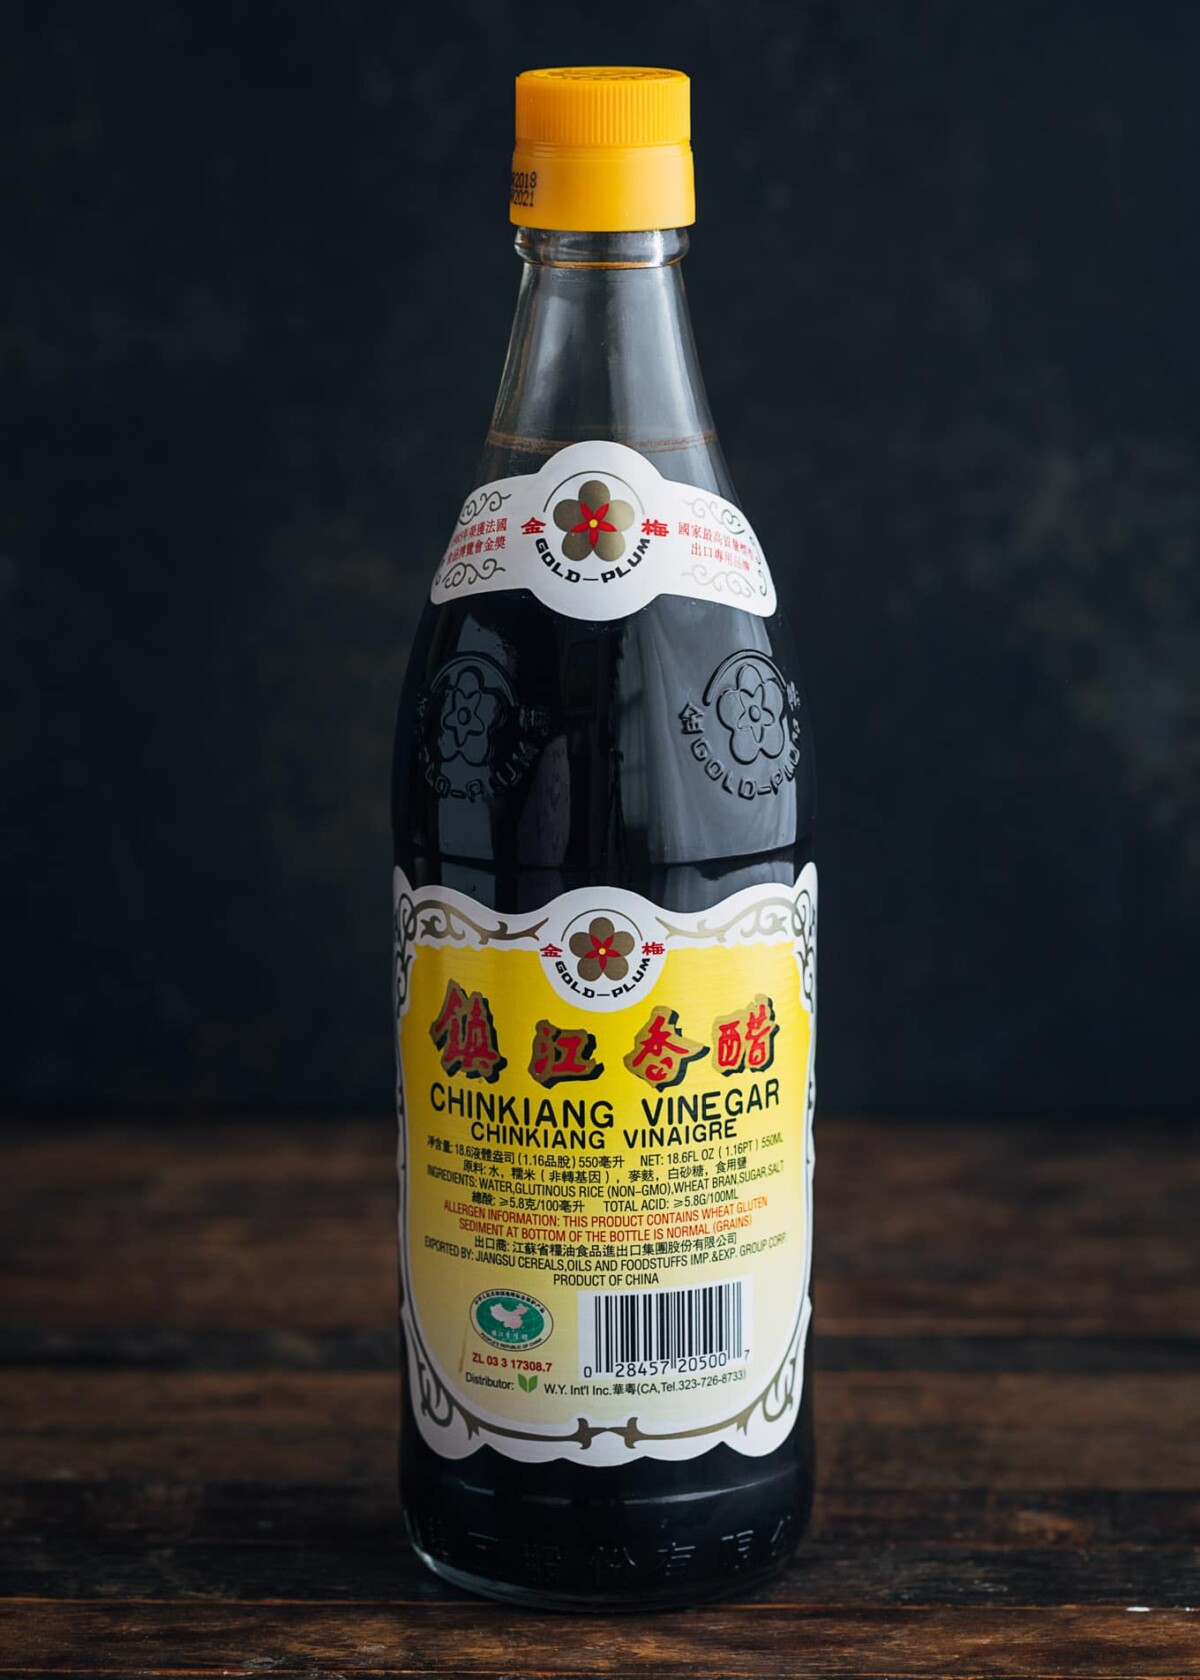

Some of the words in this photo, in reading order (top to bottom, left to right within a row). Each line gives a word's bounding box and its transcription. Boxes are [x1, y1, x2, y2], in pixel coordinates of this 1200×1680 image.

[521, 516, 546, 535] 金
[641, 518, 669, 537] 梅
[535, 538, 651, 583] GOLD-PLUM
[540, 943, 563, 958] 金
[642, 942, 665, 956] 梅
[555, 957, 651, 998] GOLD-PLUM
[430, 1081, 614, 1128] CHINKIANG
[642, 1078, 780, 1126] VINEGAR
[471, 1120, 605, 1150] CHINKIANG
[623, 1118, 737, 1149] VINAIGRE
[640, 1154, 664, 1167] NET:
[667, 1151, 698, 1165] 18.6FL
[702, 1147, 714, 1160] OZ
[761, 1131, 784, 1150] 550ML
[427, 1164, 477, 1188] INGREDIENTS:
[579, 1186, 604, 1198] RICE
[444, 1200, 485, 1219] ALLERGEN
[488, 1208, 560, 1228] INFORMATION:
[563, 1215, 588, 1228] THIS
[592, 1215, 643, 1229] PRODUCT
[647, 1209, 699, 1226] CONTAINS
[701, 1204, 734, 1220] WHEAT
[737, 1196, 768, 1213] GLUTEN
[604, 1201, 638, 1213] TOTAL
[641, 1199, 669, 1211] ACID:
[459, 1217, 505, 1237] SEDIMENT
[506, 1226, 519, 1238] AT
[522, 1228, 566, 1242] BOTTOM
[569, 1230, 583, 1243] OF
[585, 1231, 606, 1243] THE
[610, 1230, 650, 1243] BOTTLE
[654, 1228, 664, 1240] IS
[667, 1223, 710, 1239] NORMAL
[712, 1215, 753, 1234] (GRAINS)
[424, 1235, 459, 1258] EXPORTED
[461, 1247, 474, 1261] BY:
[475, 1250, 515, 1267] JIANGSU
[595, 1260, 618, 1273] AND
[621, 1254, 688, 1271] FOODSTUFFS
[740, 1239, 768, 1256] GROUP
[554, 1273, 606, 1287] PRODUCT
[609, 1274, 623, 1286] OF
[625, 1273, 659, 1286] CHINA
[472, 1352, 485, 1364] ZL
[487, 1356, 499, 1367] 03
[501, 1358, 507, 1368] 3
[511, 1359, 552, 1372] 17308.7
[584, 1366, 592, 1379] 0
[615, 1361, 669, 1378] 28457
[678, 1352, 727, 1373] 20500
[744, 1349, 750, 1361] 7
[465, 1371, 515, 1391] Distributor:
[544, 1383, 567, 1395] W.Y.
